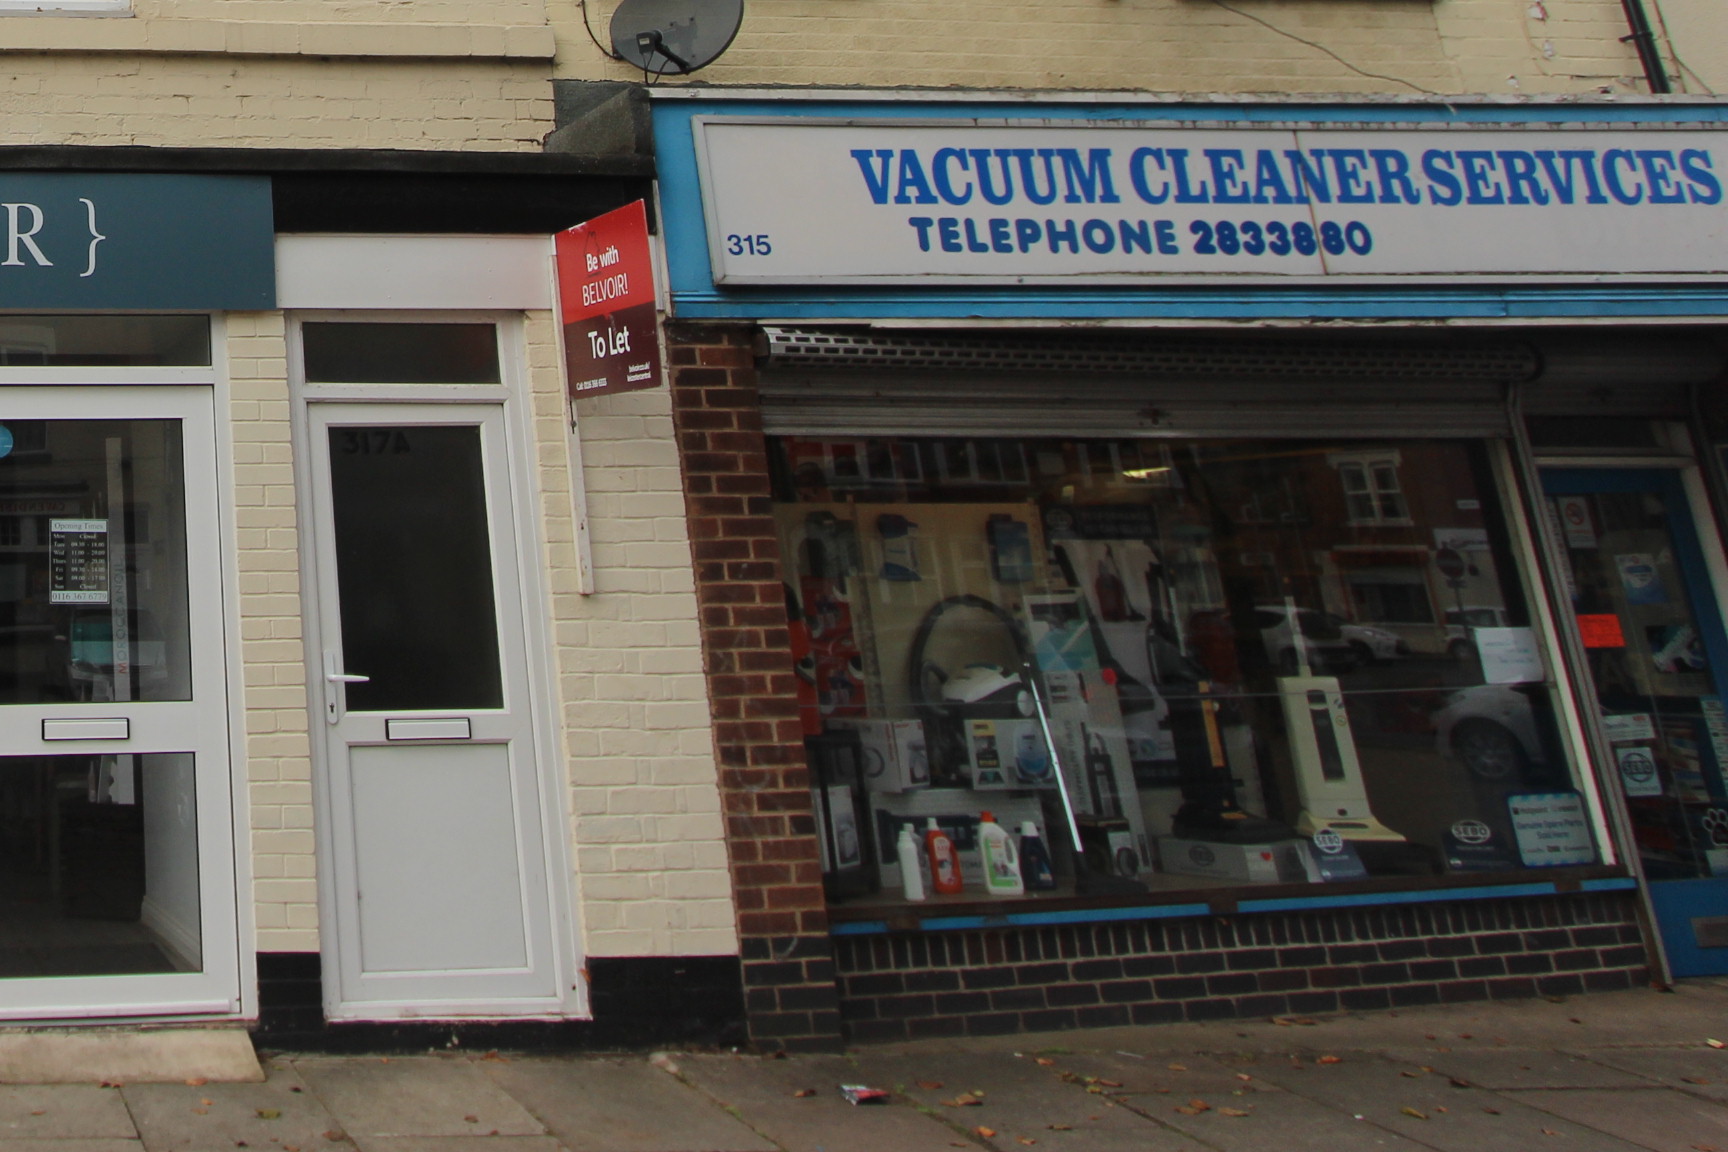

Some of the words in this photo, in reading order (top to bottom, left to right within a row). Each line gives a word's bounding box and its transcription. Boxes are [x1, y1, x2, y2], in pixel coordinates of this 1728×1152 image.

[851, 148, 1120, 205] VACUUM
[1128, 147, 1421, 206] CLEANER
[1422, 149, 1722, 208] SERVICES
[727, 233, 772, 256] 315
[908, 216, 1179, 255] TELEPHONE
[1189, 219, 1372, 256] 2833880
[586, 252, 599, 273] Be
[600, 245, 619, 268] with
[582, 274, 628, 306] BELVOIR!
[588, 331, 606, 359] To
[608, 326, 630, 355] Let
[344, 431, 410, 454] 317A
[55, 522, 81, 530] Opening
[52, 592, 70, 600] 0116
